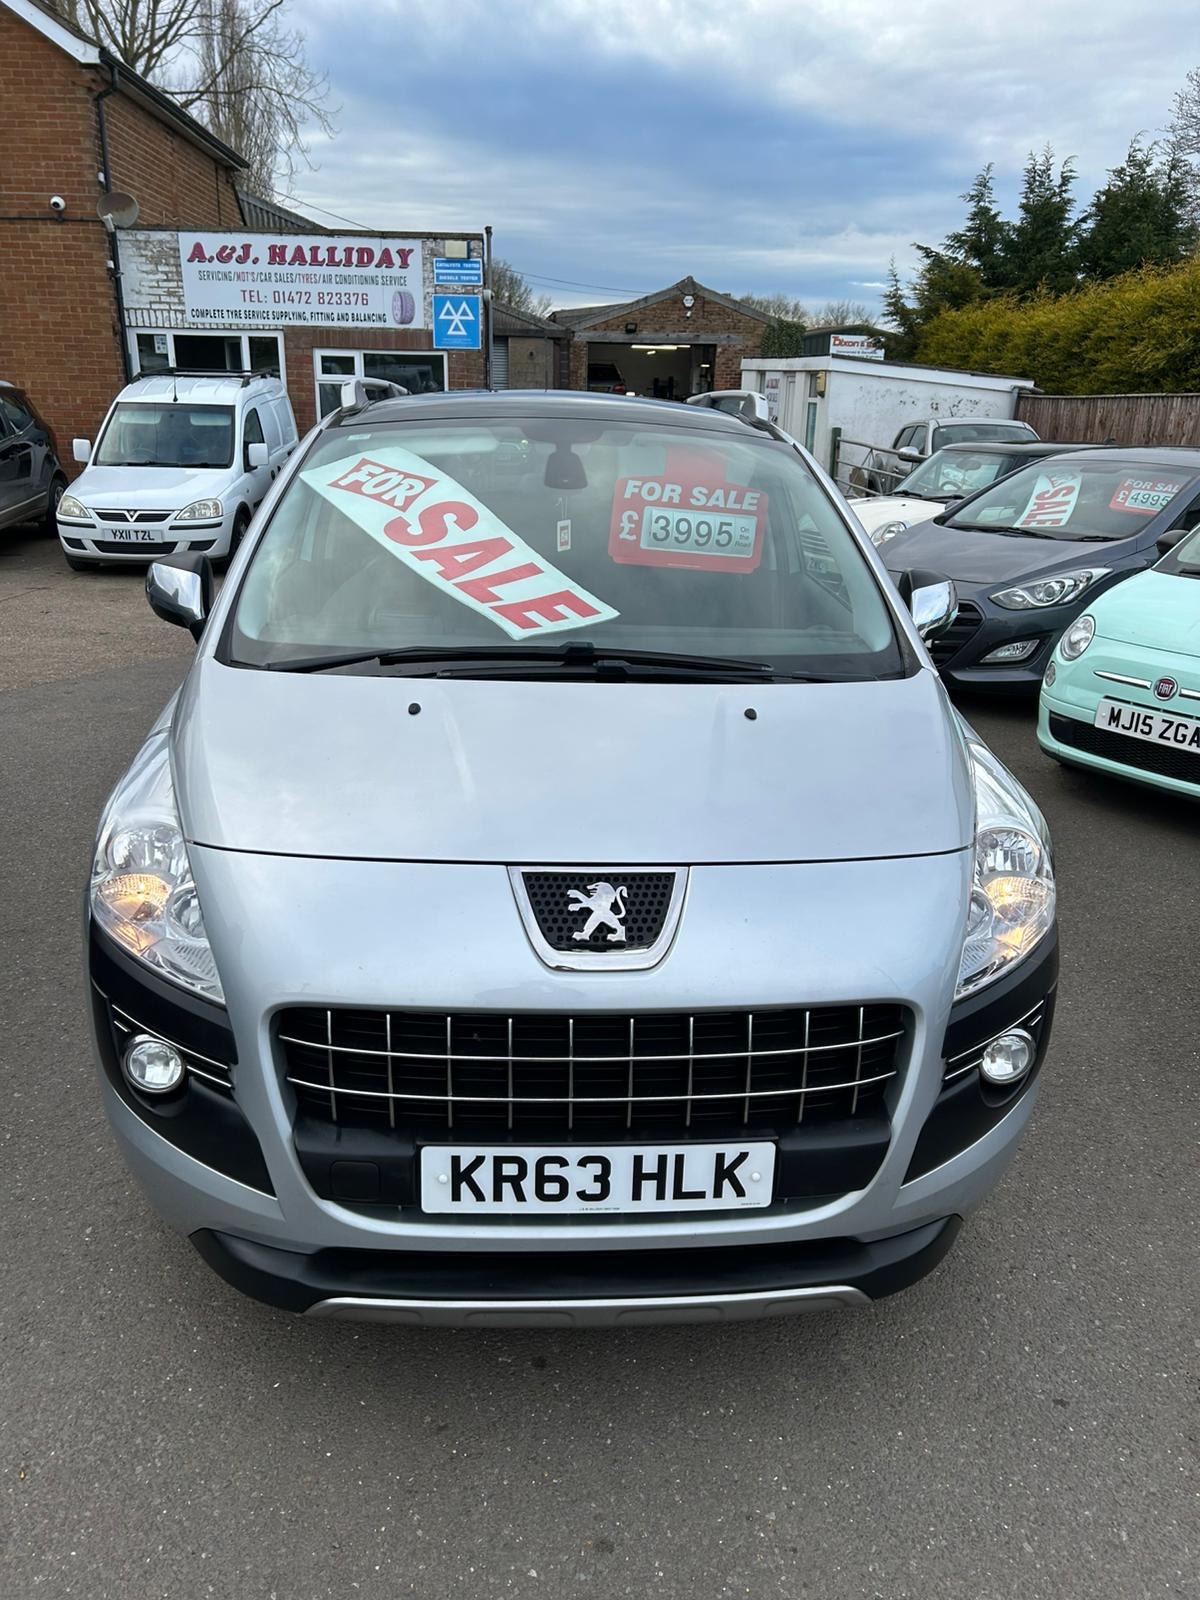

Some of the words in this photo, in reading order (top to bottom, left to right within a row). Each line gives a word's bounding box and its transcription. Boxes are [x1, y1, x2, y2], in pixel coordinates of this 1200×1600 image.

[267, 243, 415, 270] HALLIDAY
[274, 271, 333, 285] SALES/TYRES/AIR
[335, 274, 380, 286] CONDITIONING
[381, 275, 407, 287] SERVICE
[240, 289, 268, 303] TEL:
[273, 290, 311, 305] 01472
[318, 291, 369, 306] 823376
[191, 308, 225, 319] COMPLETE
[226, 309, 242, 319] TYRE
[243, 309, 270, 320] SERVICE
[271, 310, 309, 322] SUPPLYING,
[310, 312, 334, 322] FITTING
[336, 312, 349, 322] AND
[351, 313, 387, 323] BALANCING
[338, 464, 425, 507] FOR
[623, 479, 682, 504] FOR
[689, 486, 761, 511] SALE
[1124, 478, 1153, 490] FOR
[1154, 483, 1182, 493] SAL
[1020, 485, 1076, 526] SALE
[1131, 492, 1171, 507] 4995
[133, 530, 155, 541] TZL
[652, 515, 733, 548] 3995
[384, 500, 602, 630] SALE
[1158, 682, 1173, 694] FIAT
[1107, 706, 1154, 736] MJ15
[1158, 718, 1200, 749] ZGA
[450, 1154, 612, 1203] KR63
[631, 1151, 750, 1202] HLK
